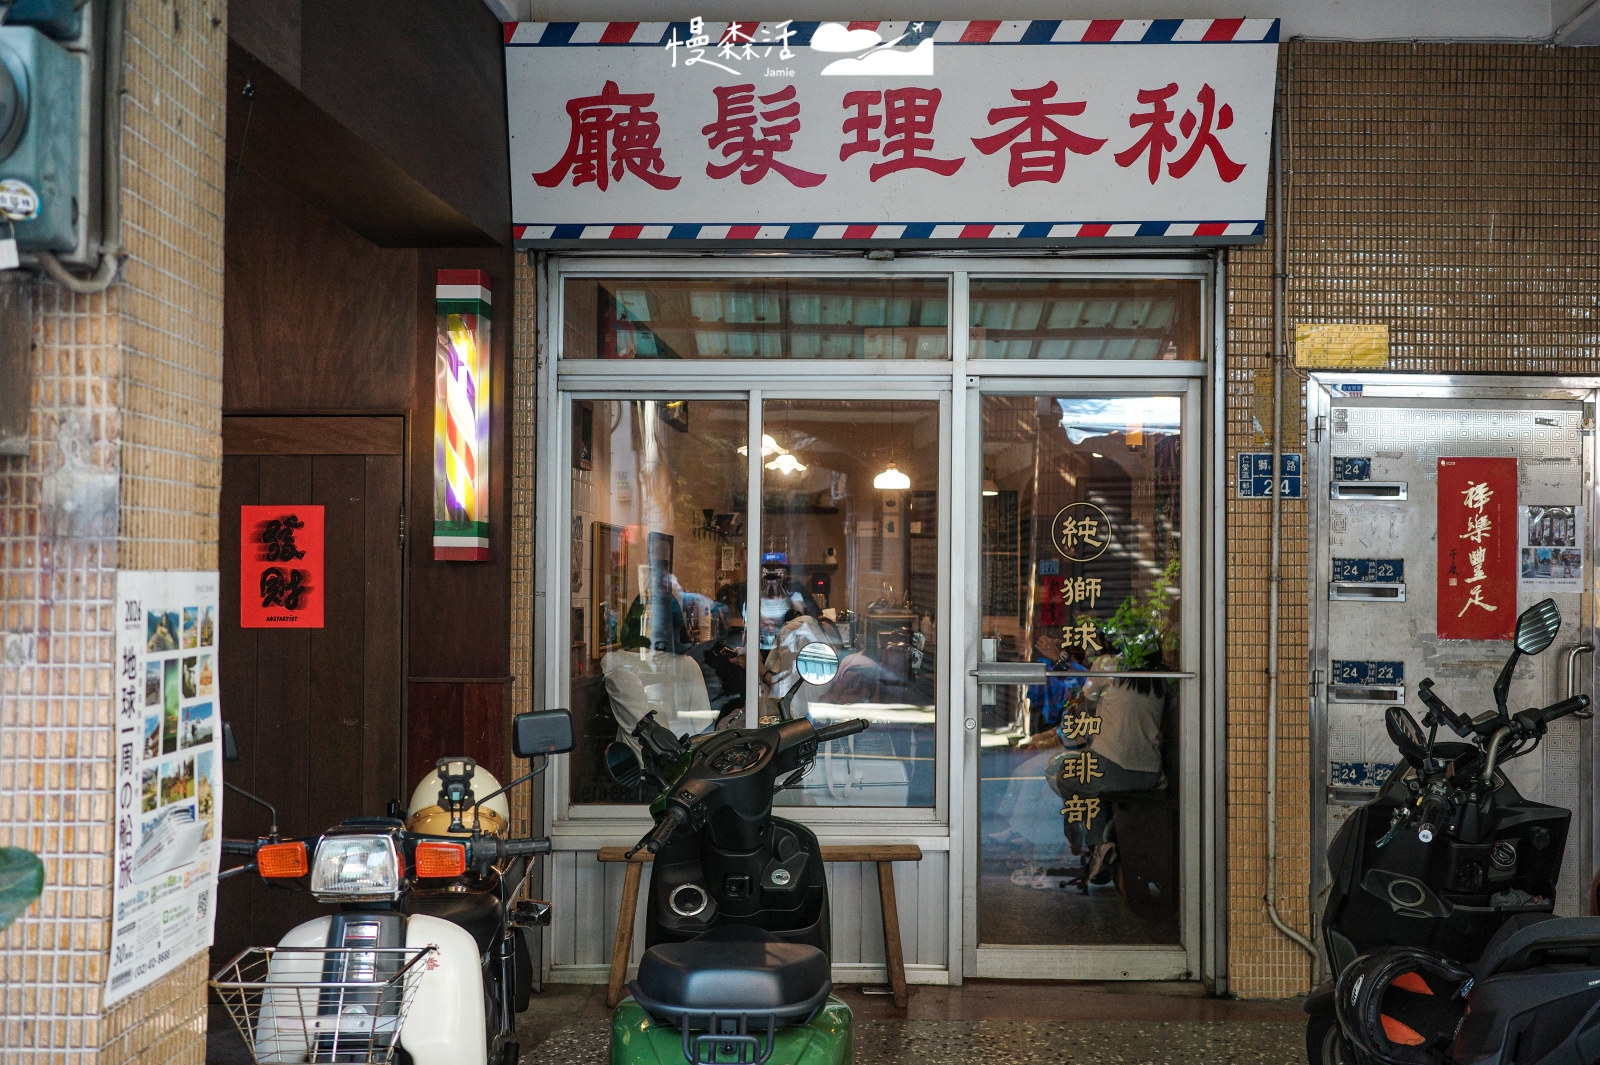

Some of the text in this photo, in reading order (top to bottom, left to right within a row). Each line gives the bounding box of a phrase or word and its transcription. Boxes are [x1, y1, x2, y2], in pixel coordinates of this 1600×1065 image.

[532, 80, 1247, 192] 秋香理髮廳
[1258, 459, 1296, 472] 獅路
[1345, 464, 1360, 475] 24
[1263, 479, 1290, 495] 24
[1343, 565, 1358, 576] 24
[1378, 565, 1394, 576] 22
[125, 600, 142, 622] 2026
[1342, 667, 1358, 678] 24
[1377, 668, 1393, 679] 22
[118, 646, 137, 890] 地球一周の船旅
[1341, 768, 1357, 779] 24
